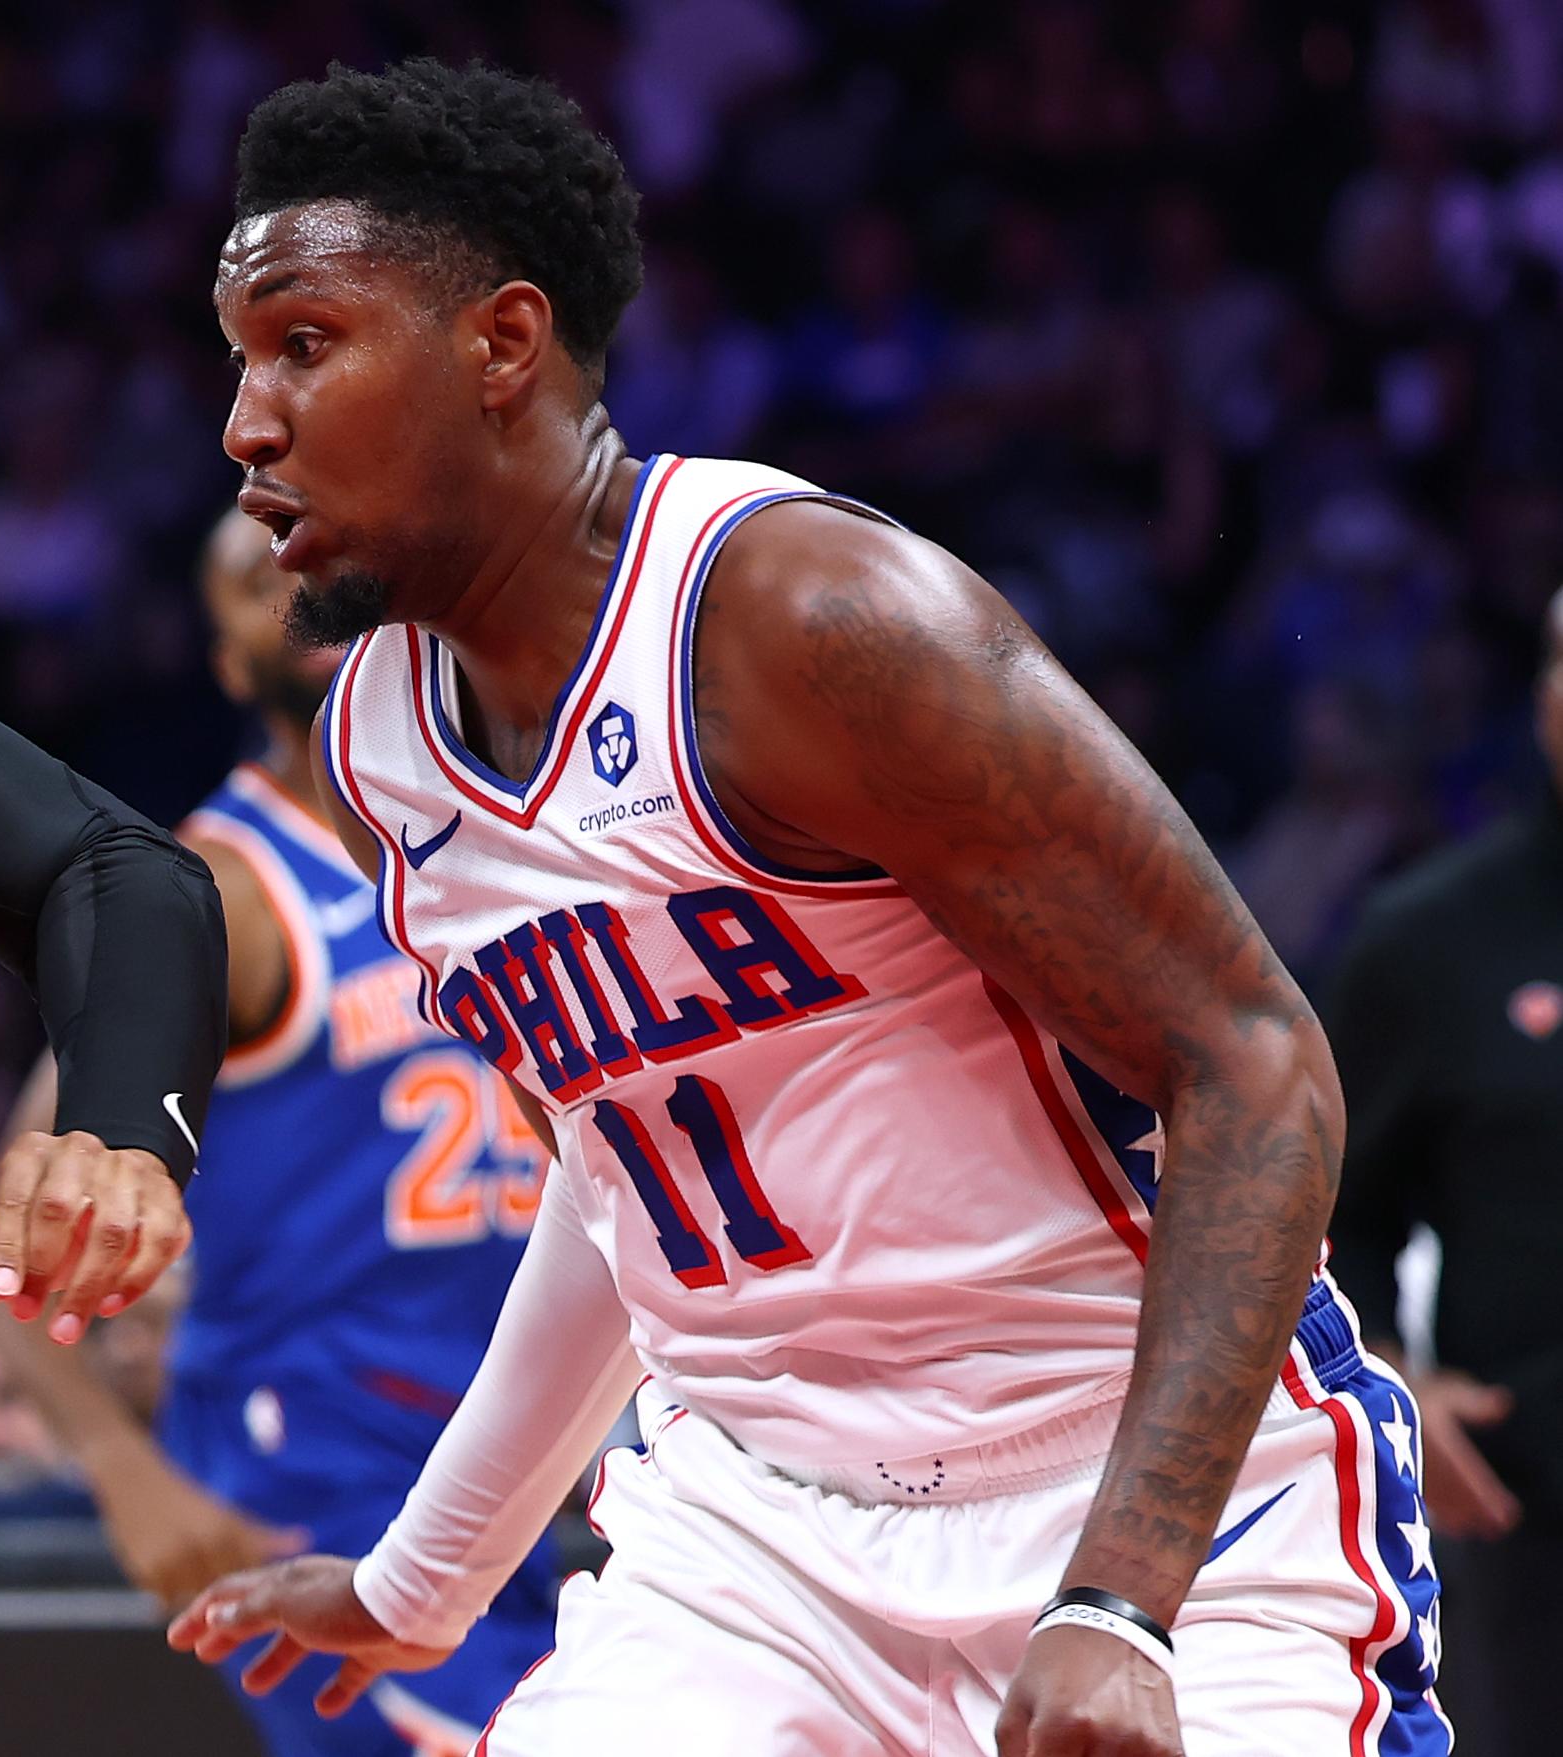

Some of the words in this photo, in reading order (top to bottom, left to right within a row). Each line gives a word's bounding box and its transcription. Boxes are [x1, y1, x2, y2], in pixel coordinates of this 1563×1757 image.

[579, 795, 675, 831] crypto.com
[438, 885, 870, 1105] PHILA
[593, 1074, 813, 1290] 11
